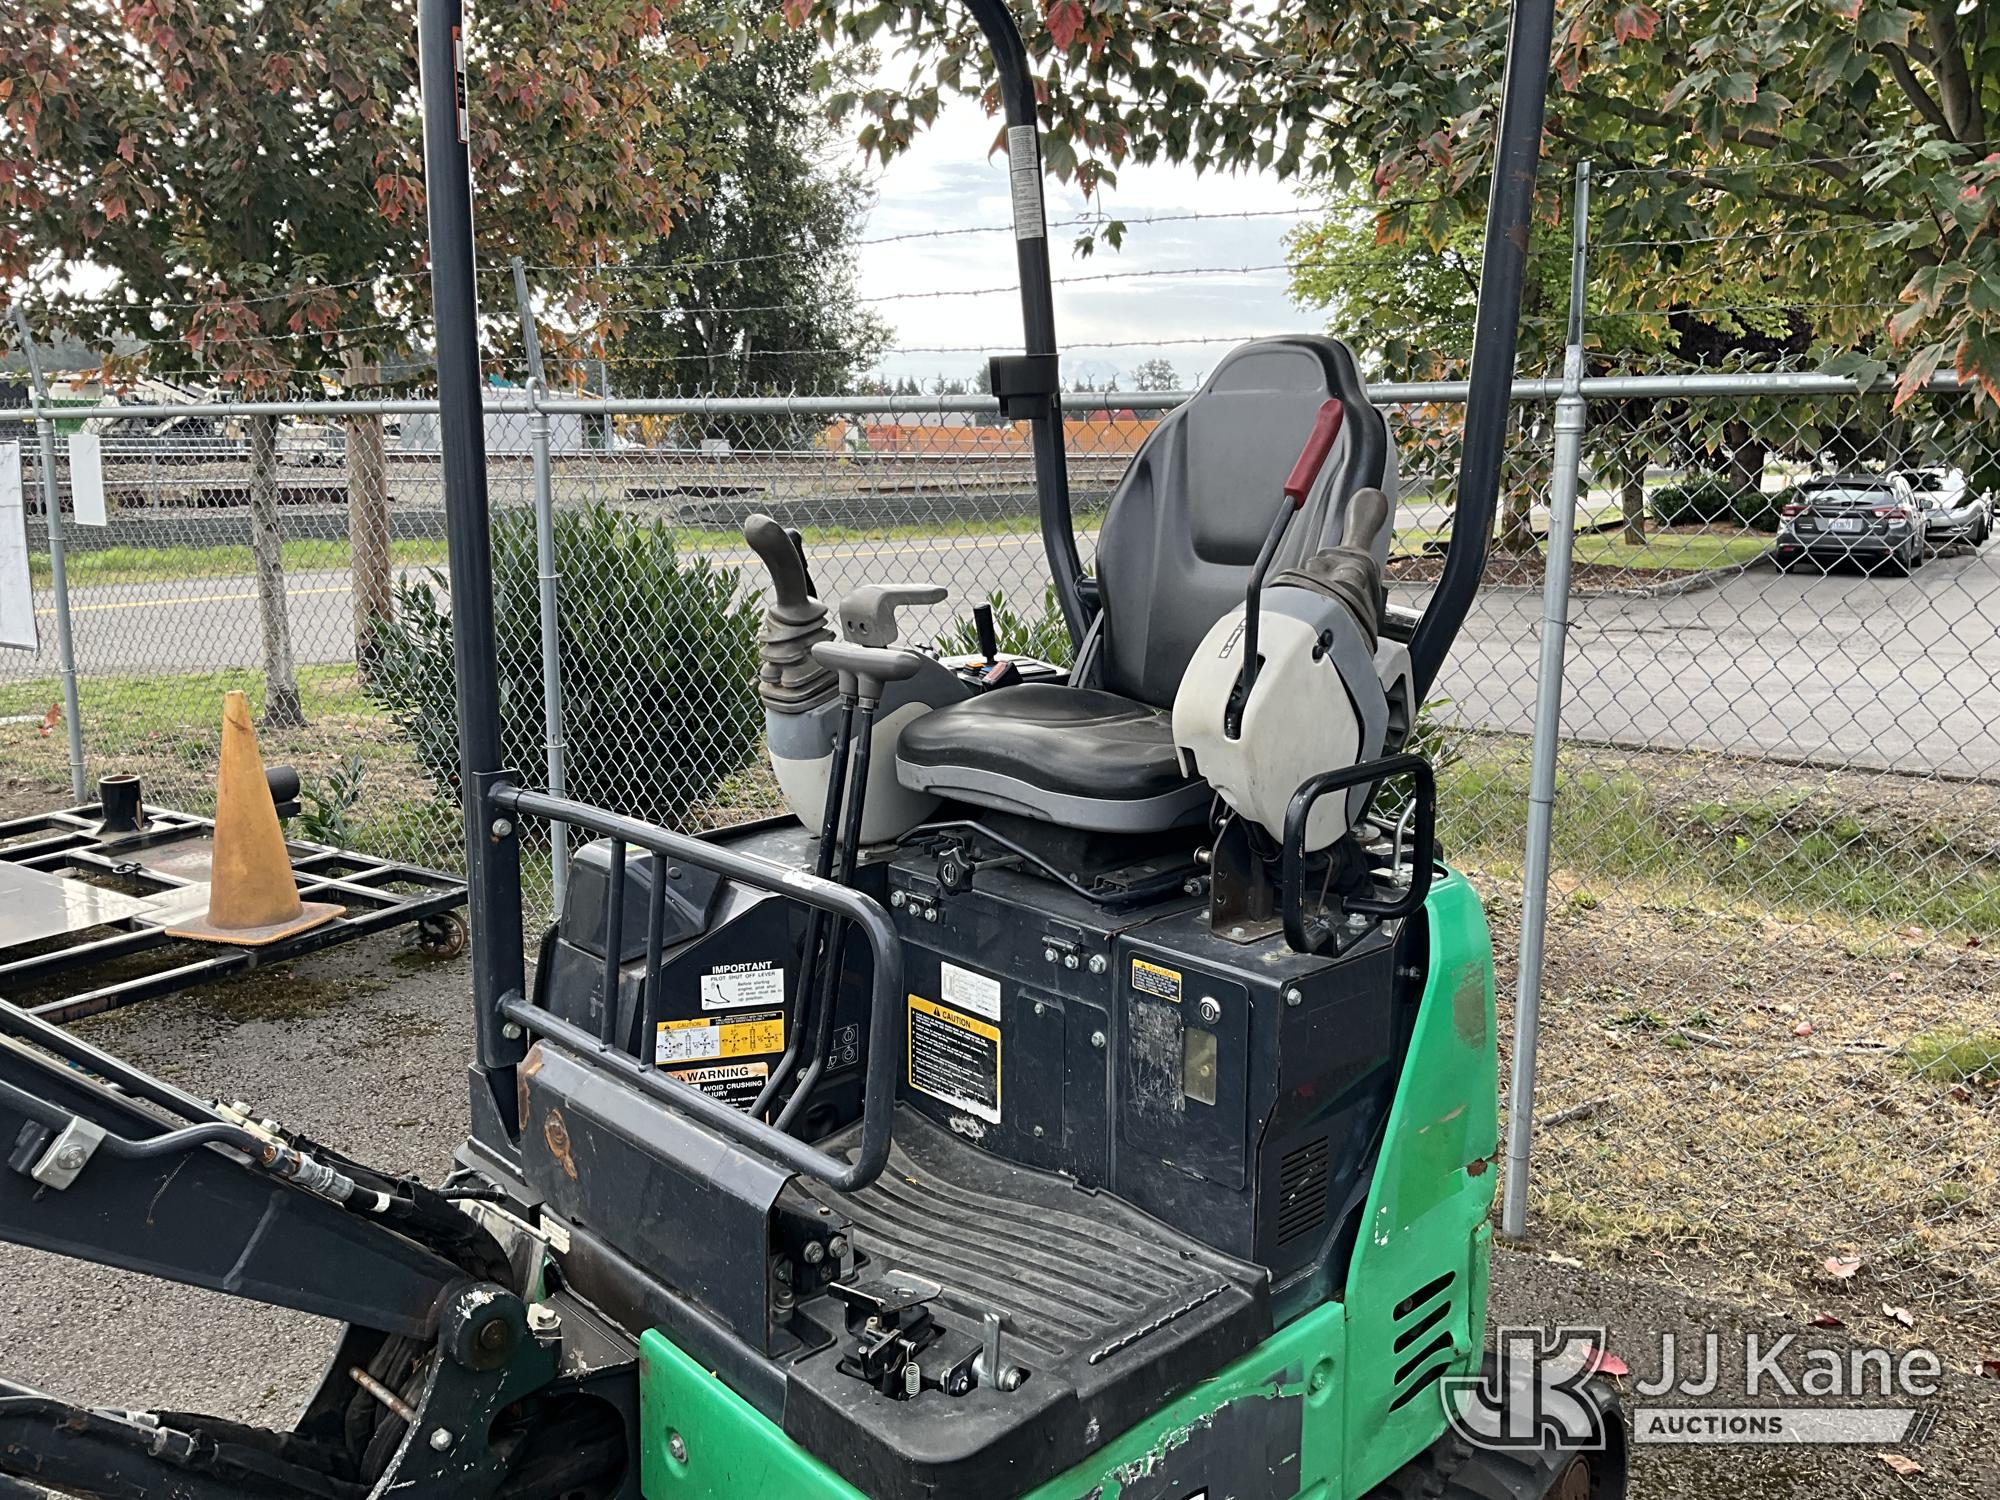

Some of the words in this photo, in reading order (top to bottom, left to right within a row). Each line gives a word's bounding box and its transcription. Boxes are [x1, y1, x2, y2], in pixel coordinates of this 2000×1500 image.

[712, 961, 773, 975] IMPORTANT
[676, 1021, 702, 1029] CAUTION
[942, 1011, 971, 1029] CAUTION
[687, 1066, 749, 1082] WARNING
[703, 1083, 724, 1092] AVOID
[726, 1080, 763, 1090] CRUSHING
